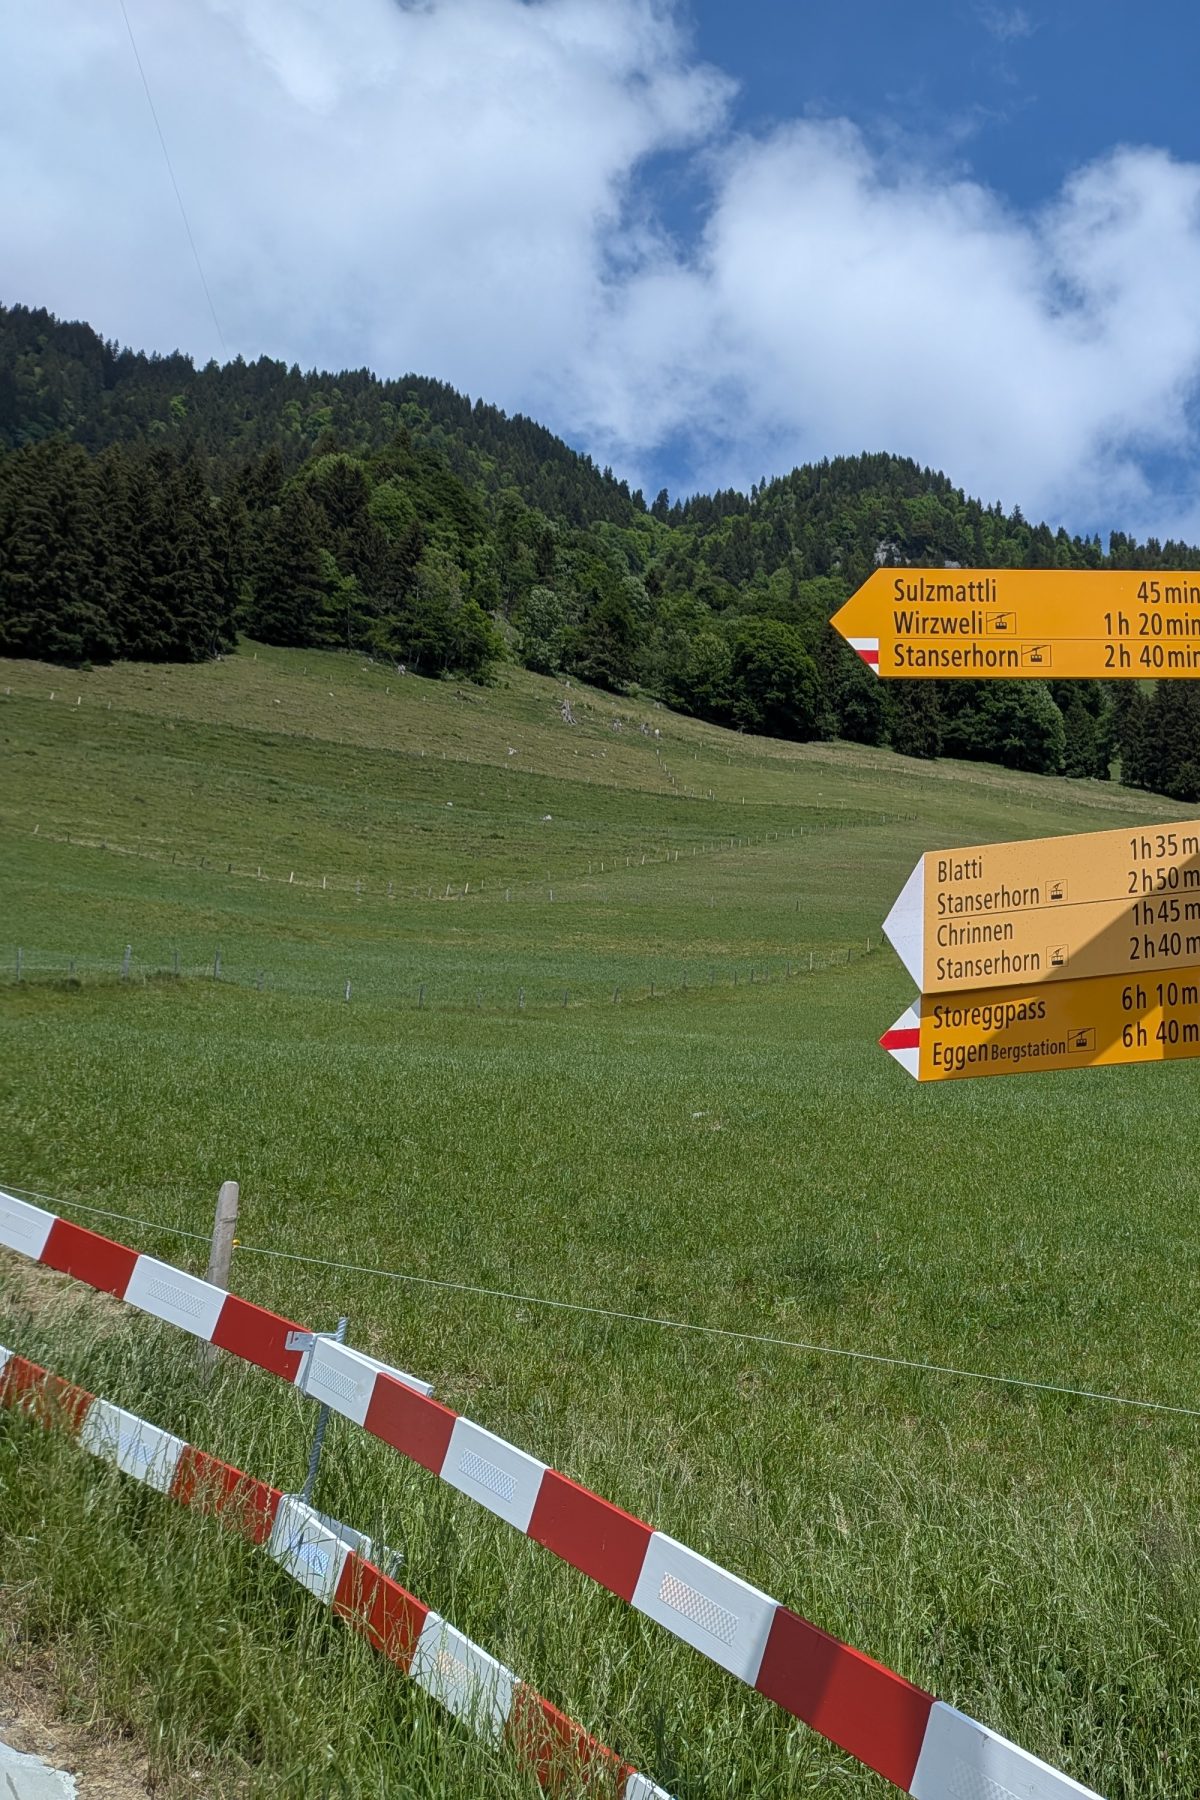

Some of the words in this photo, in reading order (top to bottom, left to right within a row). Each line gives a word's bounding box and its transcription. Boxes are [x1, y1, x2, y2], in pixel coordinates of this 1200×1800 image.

[894, 578, 997, 602] Sulzmattli
[893, 610, 983, 635] Wirzweli
[894, 643, 1019, 667] Stanserhorn
[937, 856, 983, 883] Blatti
[937, 884, 1040, 915] Stanserhorn
[937, 921, 1013, 948] Chrinnen
[936, 949, 1040, 981] Stanserhorn
[933, 1000, 1046, 1031] Storeggpass
[933, 1042, 988, 1072] Eggen
[991, 1039, 1066, 1063] Bergstation
